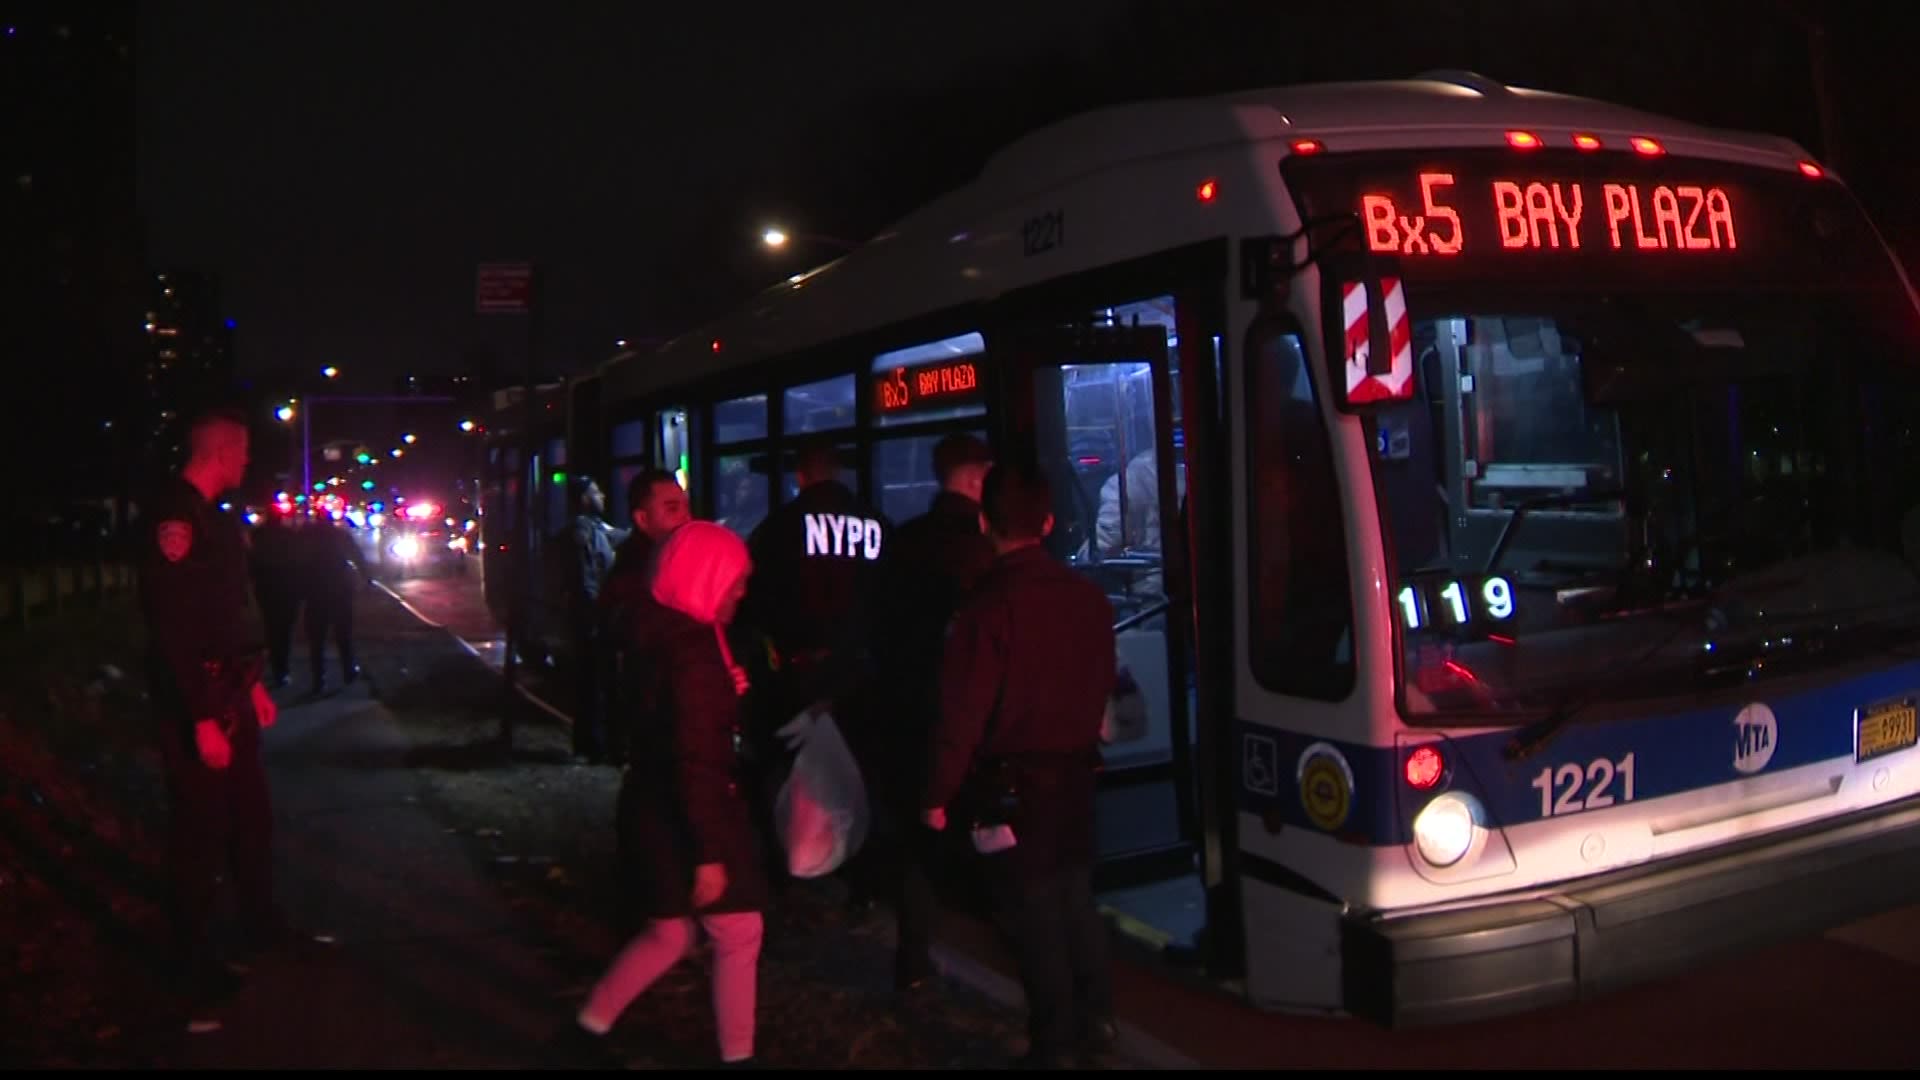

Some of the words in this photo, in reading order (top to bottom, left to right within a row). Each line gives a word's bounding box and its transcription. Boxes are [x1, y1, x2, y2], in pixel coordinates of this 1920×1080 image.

[1022, 210, 1064, 256] 1221
[1363, 173, 1463, 254] Bx5
[1493, 182, 1583, 248] BAY
[1604, 184, 1737, 249] PLAZA
[919, 370, 938, 395] BAY
[941, 364, 975, 391] PLAZA
[805, 513, 882, 560] NYPD
[1734, 722, 1769, 760] MTA
[1532, 752, 1634, 816] 1221
